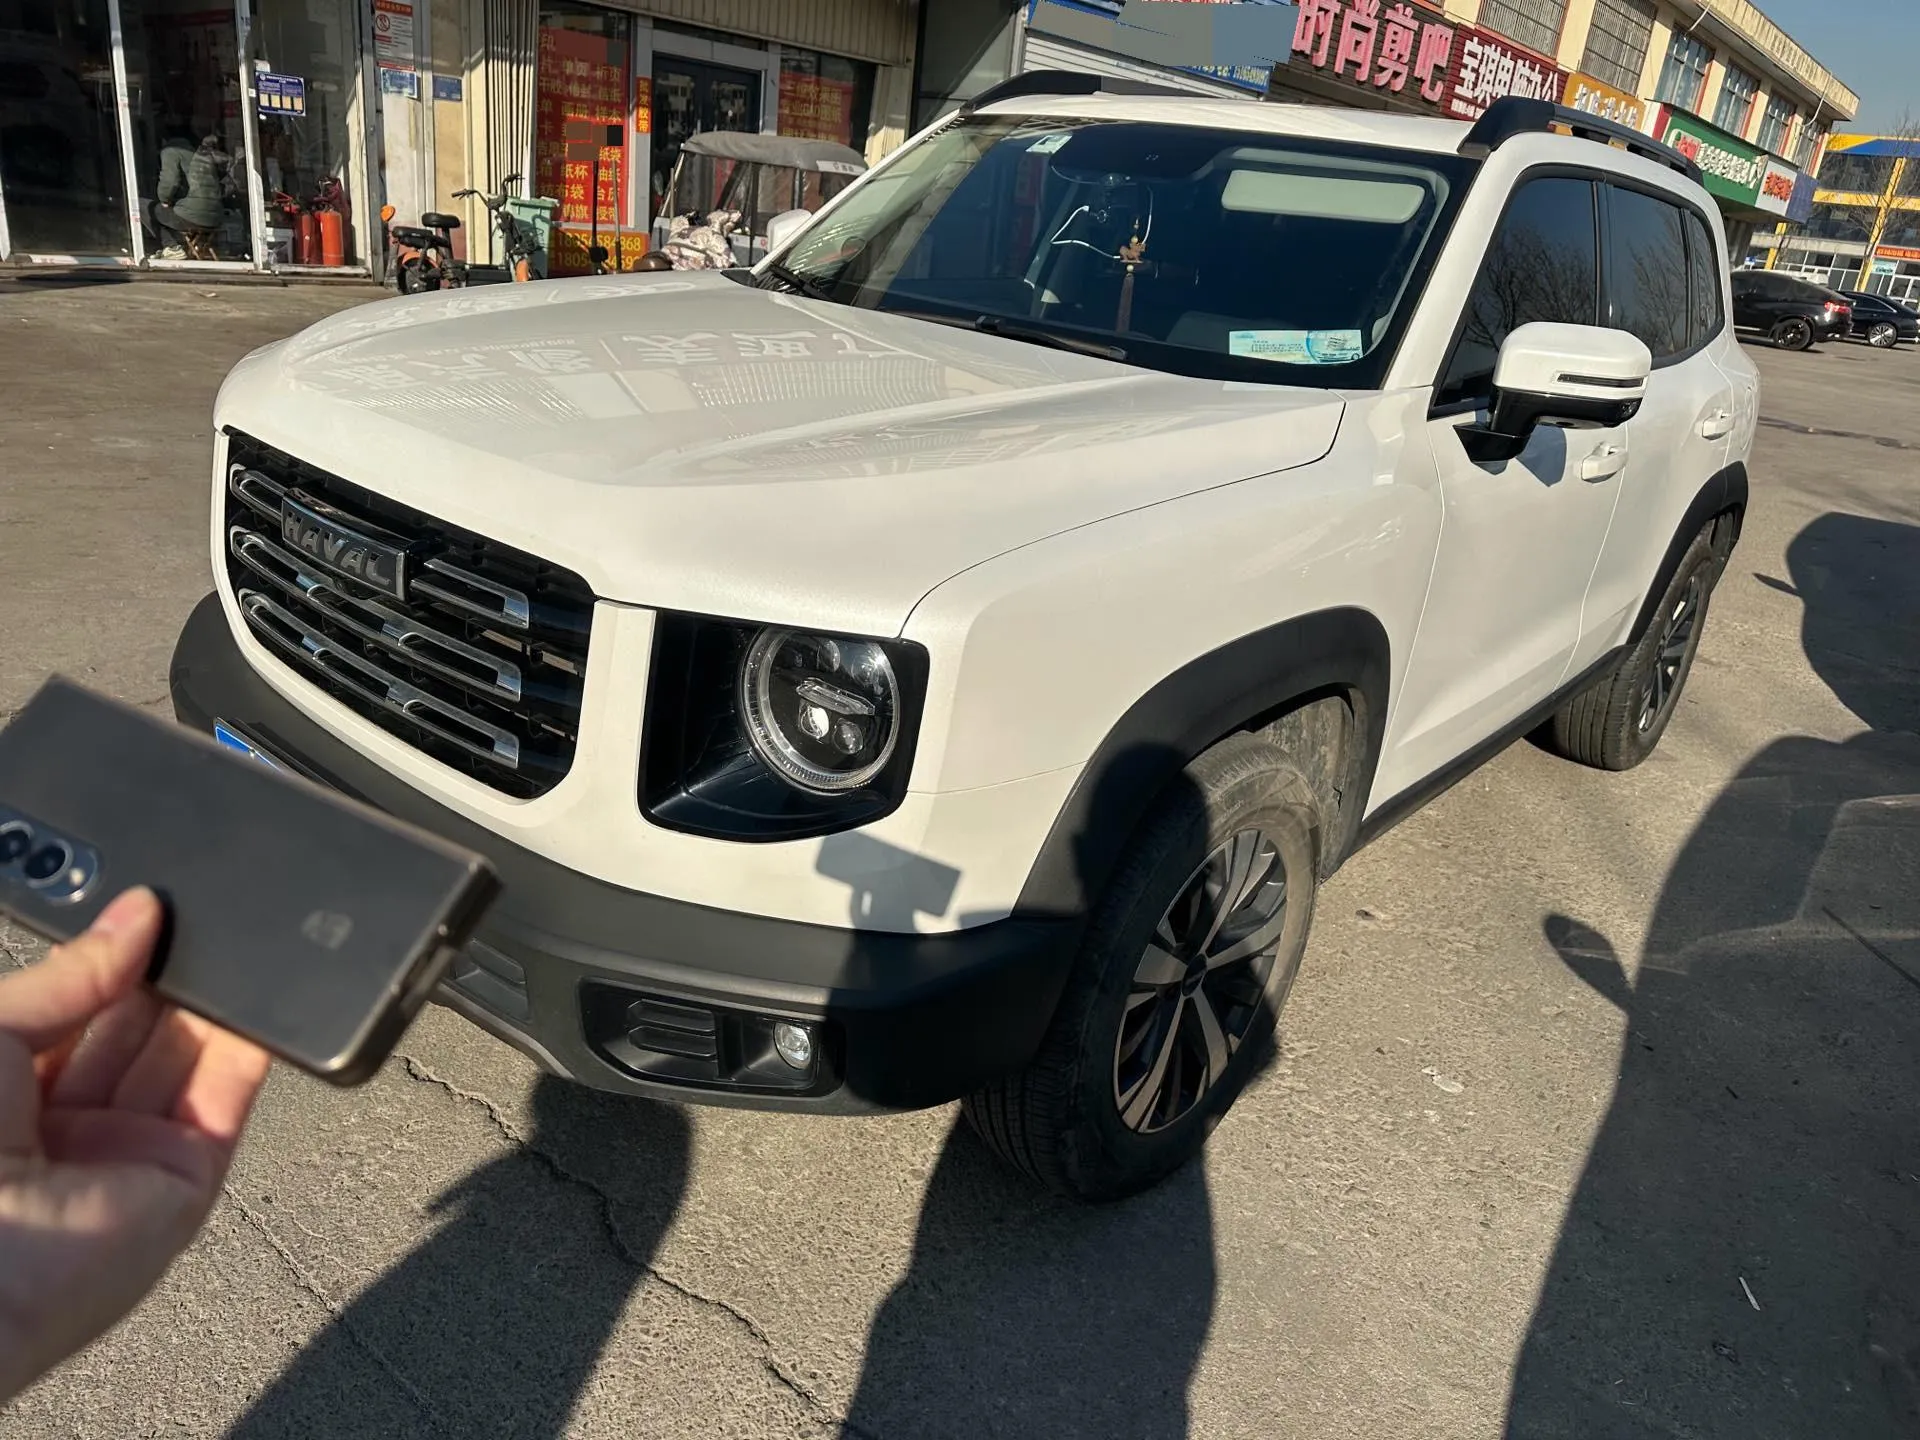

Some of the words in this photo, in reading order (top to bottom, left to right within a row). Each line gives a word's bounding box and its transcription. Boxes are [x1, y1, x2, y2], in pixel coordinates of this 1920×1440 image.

[1292, 0, 1453, 102] 时尚剪吧
[596, 105, 621, 123] 样本
[599, 146, 621, 163] 纸袋
[562, 163, 588, 180] 纸杯
[284, 510, 391, 586] HAVAL
